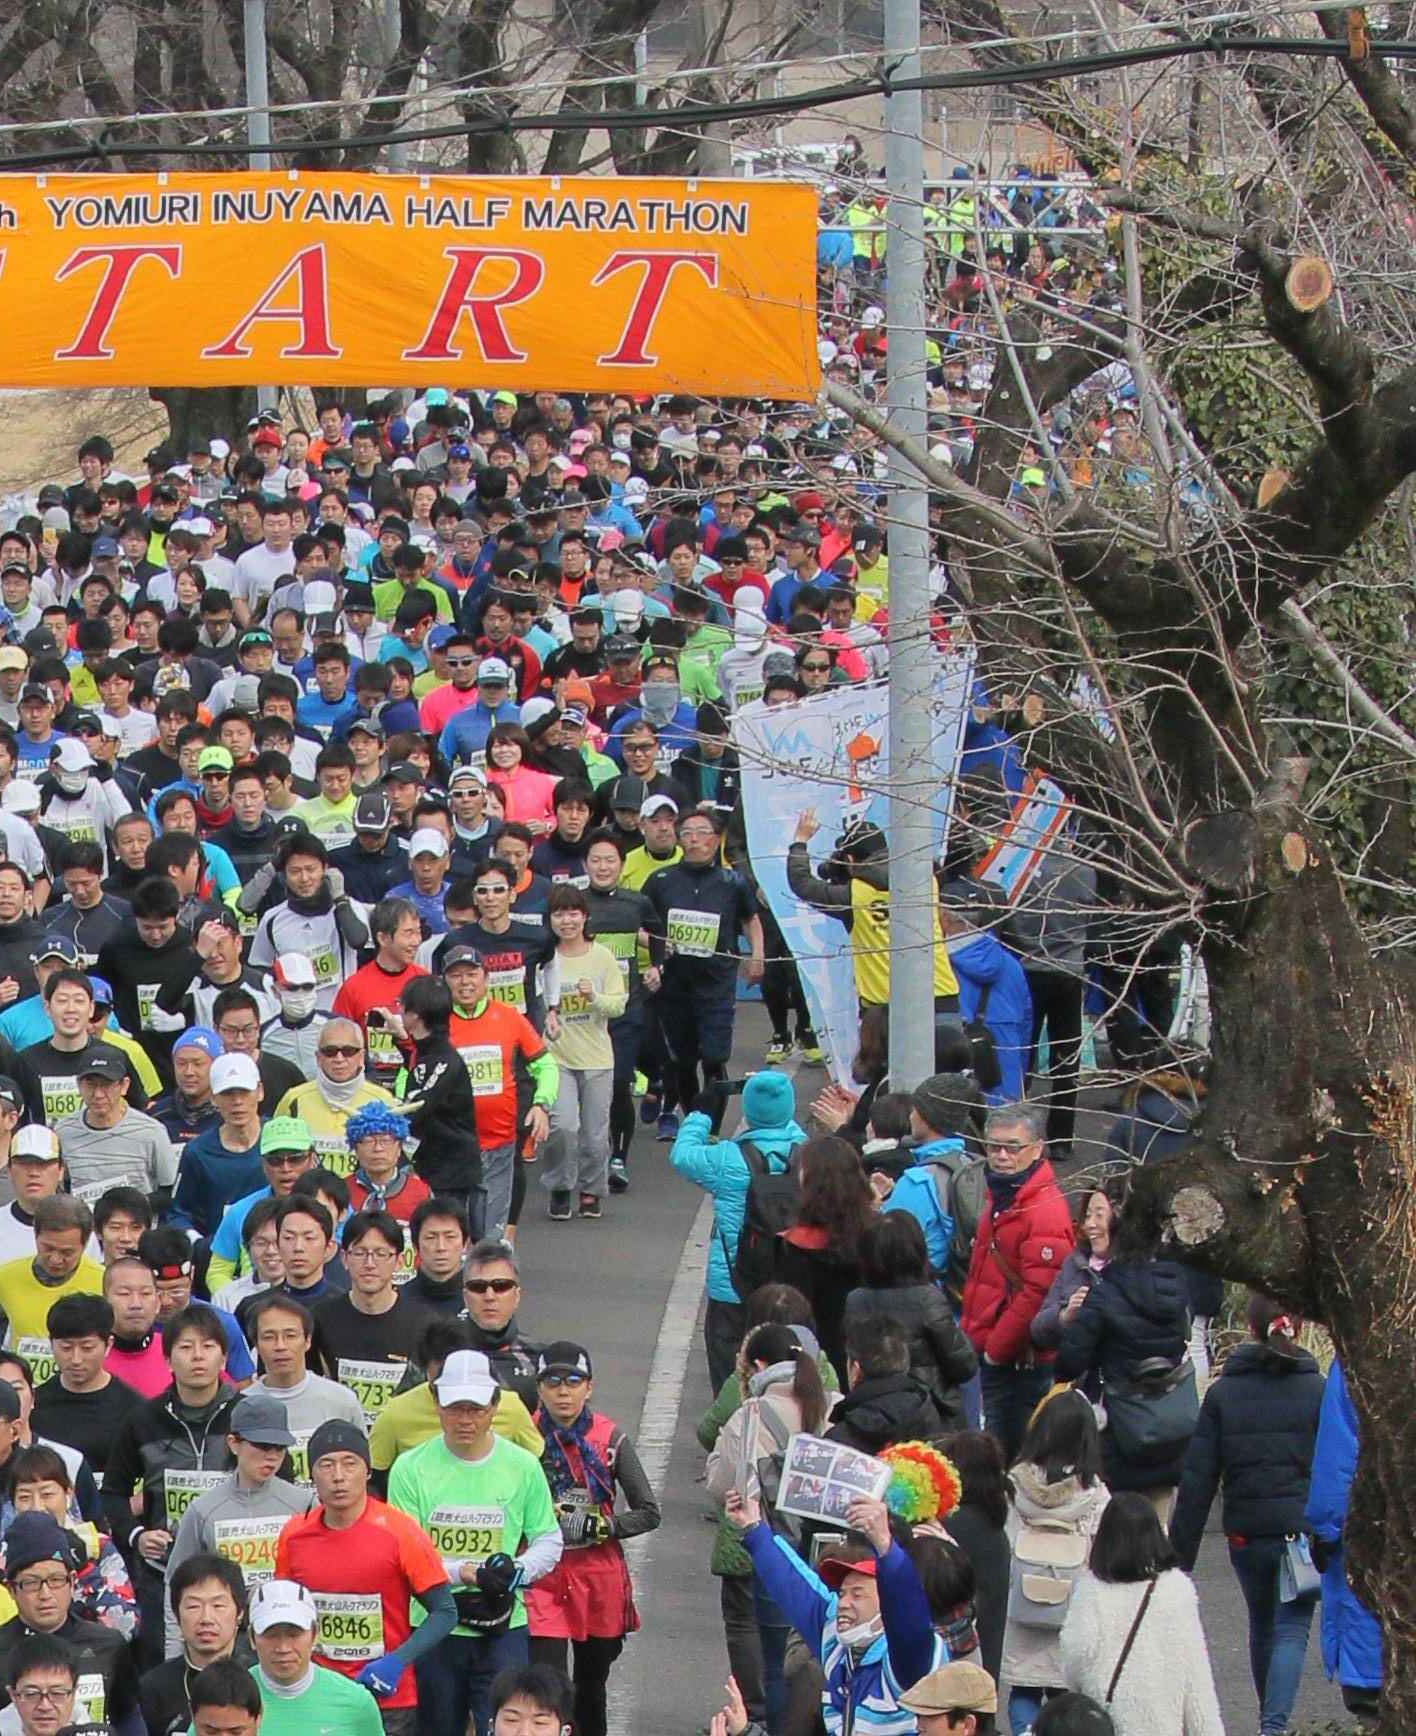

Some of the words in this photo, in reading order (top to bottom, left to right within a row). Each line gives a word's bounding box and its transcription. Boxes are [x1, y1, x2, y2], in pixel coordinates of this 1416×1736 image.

[45, 193, 199, 229] YOMIURI
[211, 190, 391, 223] INUYAMA
[407, 197, 510, 229] HALF
[523, 199, 748, 234] MARATHON
[669, 924, 711, 944] D6977
[466, 1061, 493, 1080] 981
[46, 1094, 84, 1114] D687
[319, 1153, 357, 1172] 7118
[431, 1528, 493, 1553] D6932
[318, 1615, 371, 1640] 6846
[333, 1647, 370, 1657] 2018
